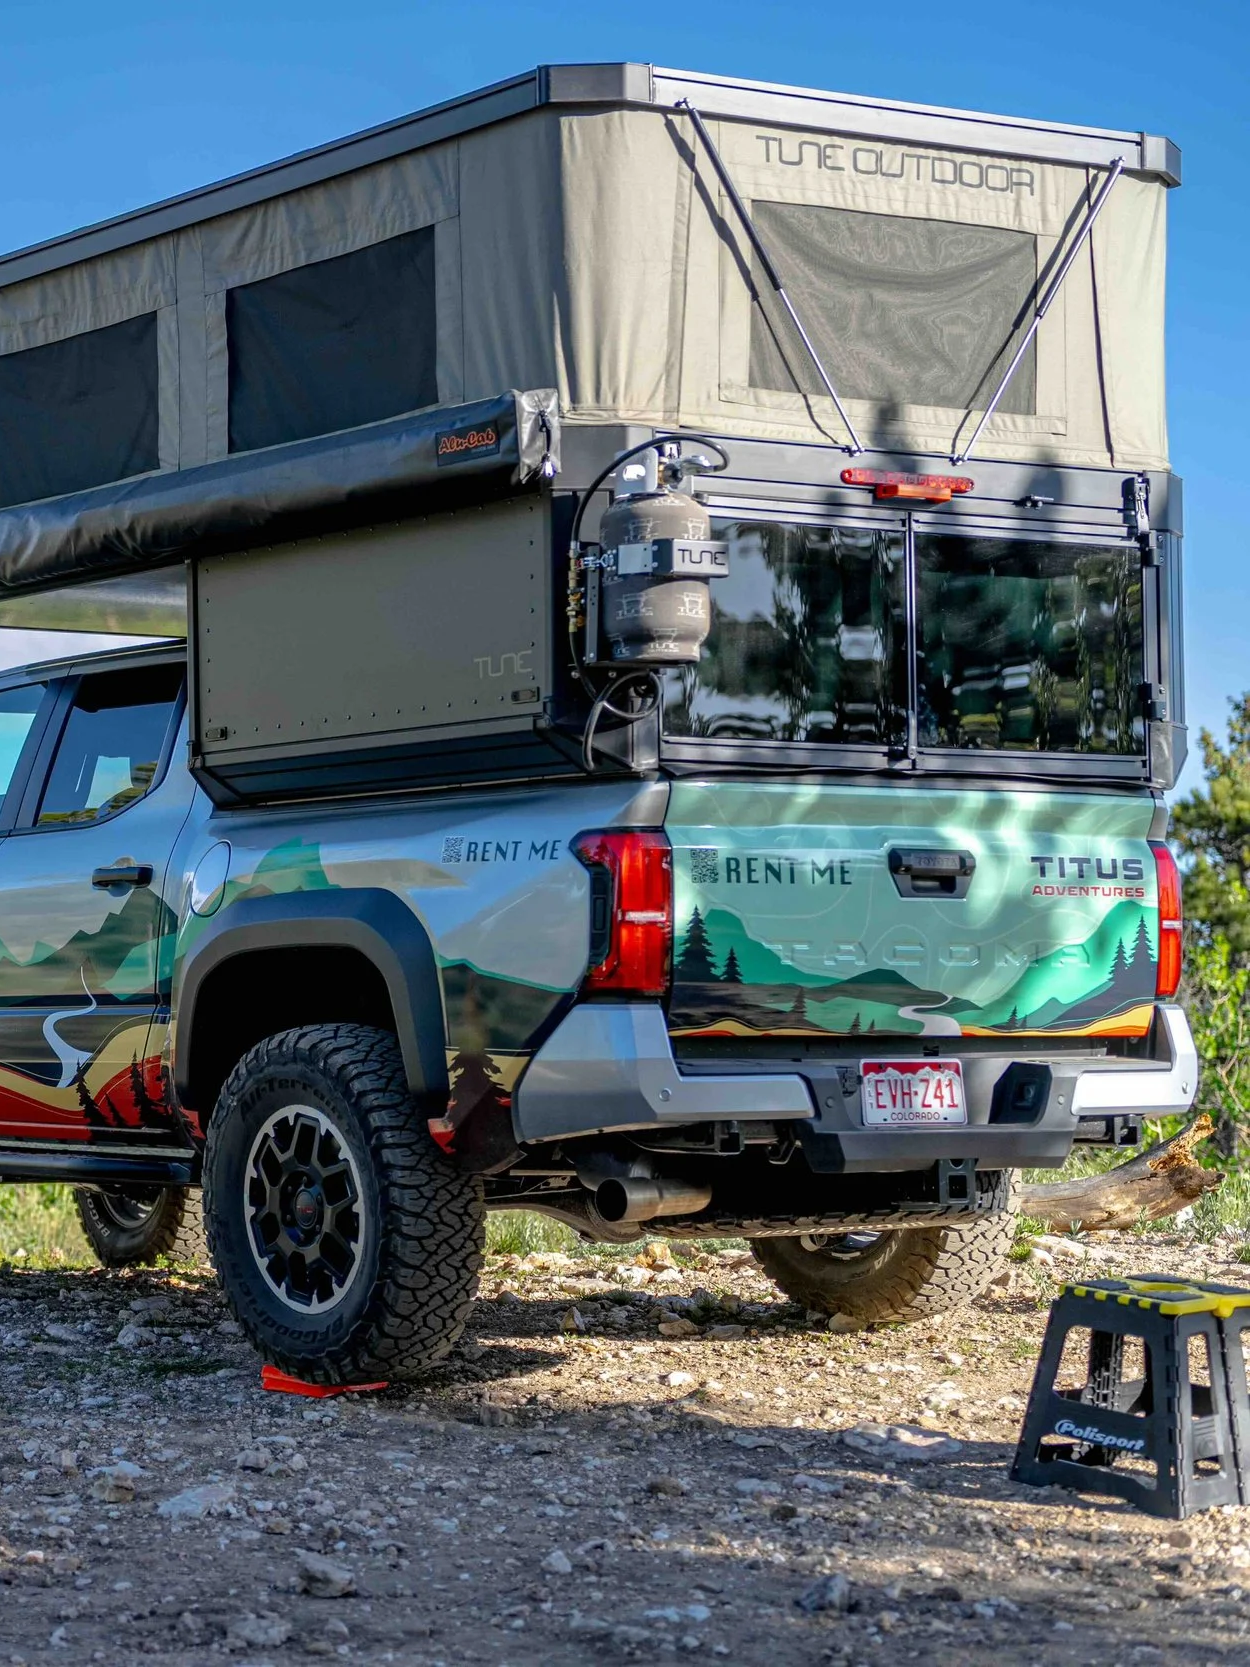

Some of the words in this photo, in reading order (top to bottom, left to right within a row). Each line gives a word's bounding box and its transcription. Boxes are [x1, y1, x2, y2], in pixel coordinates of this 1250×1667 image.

[755, 135, 844, 172] TUNE
[852, 147, 1035, 196] OUTDOOR
[438, 428, 496, 454] Alu-Cab
[677, 548, 727, 566] TUNE
[474, 651, 533, 679] TUNE
[466, 841, 522, 862] RENT
[528, 840, 562, 860] ME
[725, 857, 799, 884] RENT
[811, 858, 853, 885] ME
[1030, 856, 1144, 880] TITUS
[1031, 885, 1145, 898] ADVENTURES
[761, 940, 1091, 967] TACOMA
[891, 1111, 940, 1121] COLORADO
[1055, 1419, 1145, 1451] Polisport
